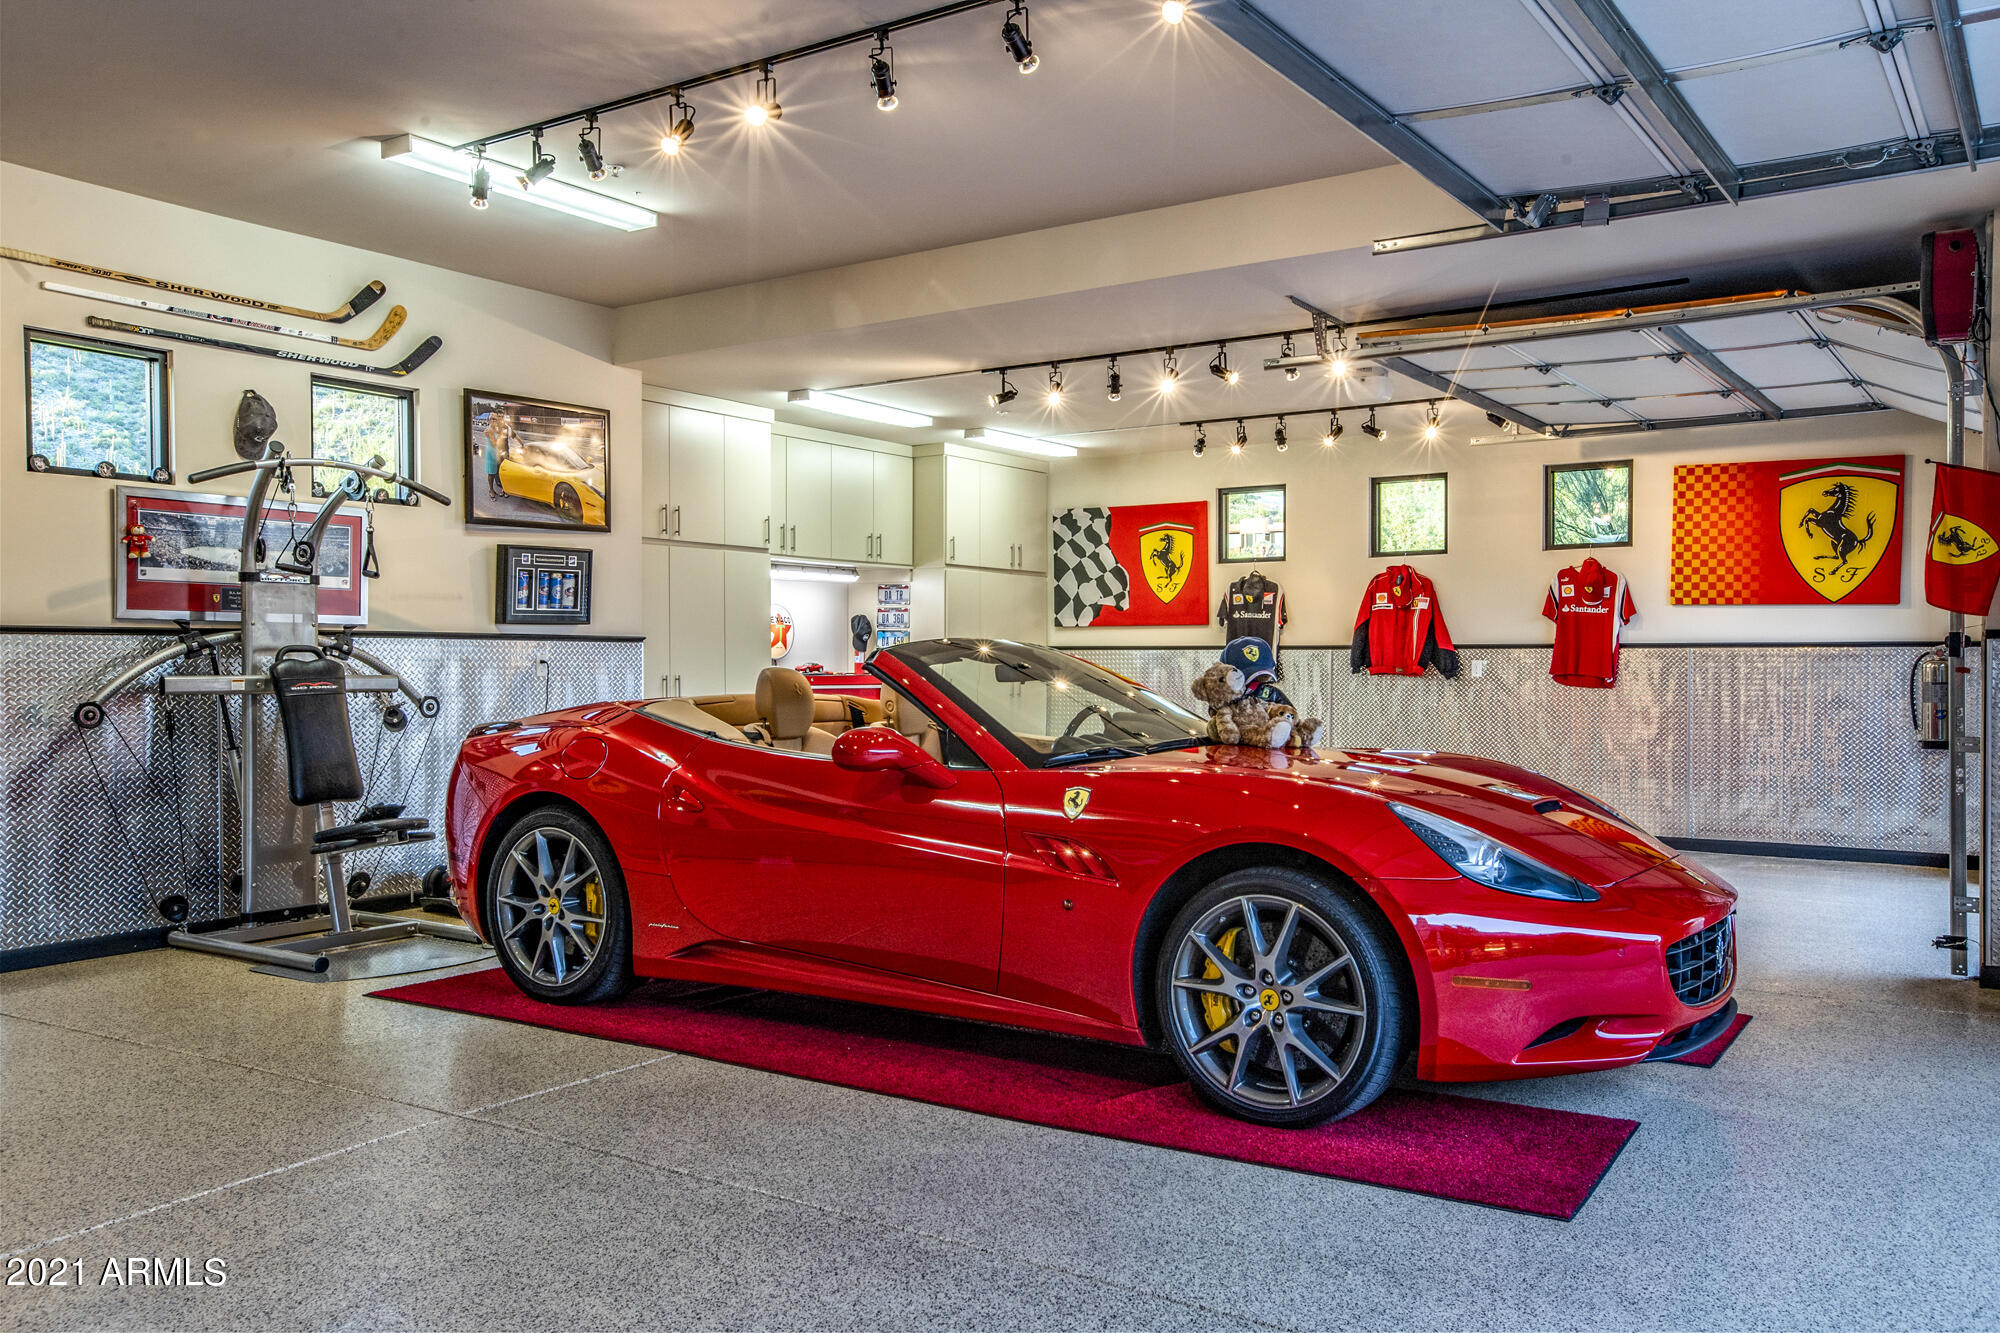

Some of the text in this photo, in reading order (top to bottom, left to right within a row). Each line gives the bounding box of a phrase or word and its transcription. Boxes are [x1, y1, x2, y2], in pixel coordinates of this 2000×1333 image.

[155, 281, 264, 307] SHER-WOOD
[276, 351, 360, 368] SHER-WOOD
[1812, 566, 1867, 583] S F
[1240, 610, 1272, 619] Santander
[1570, 604, 1609, 614] Santander
